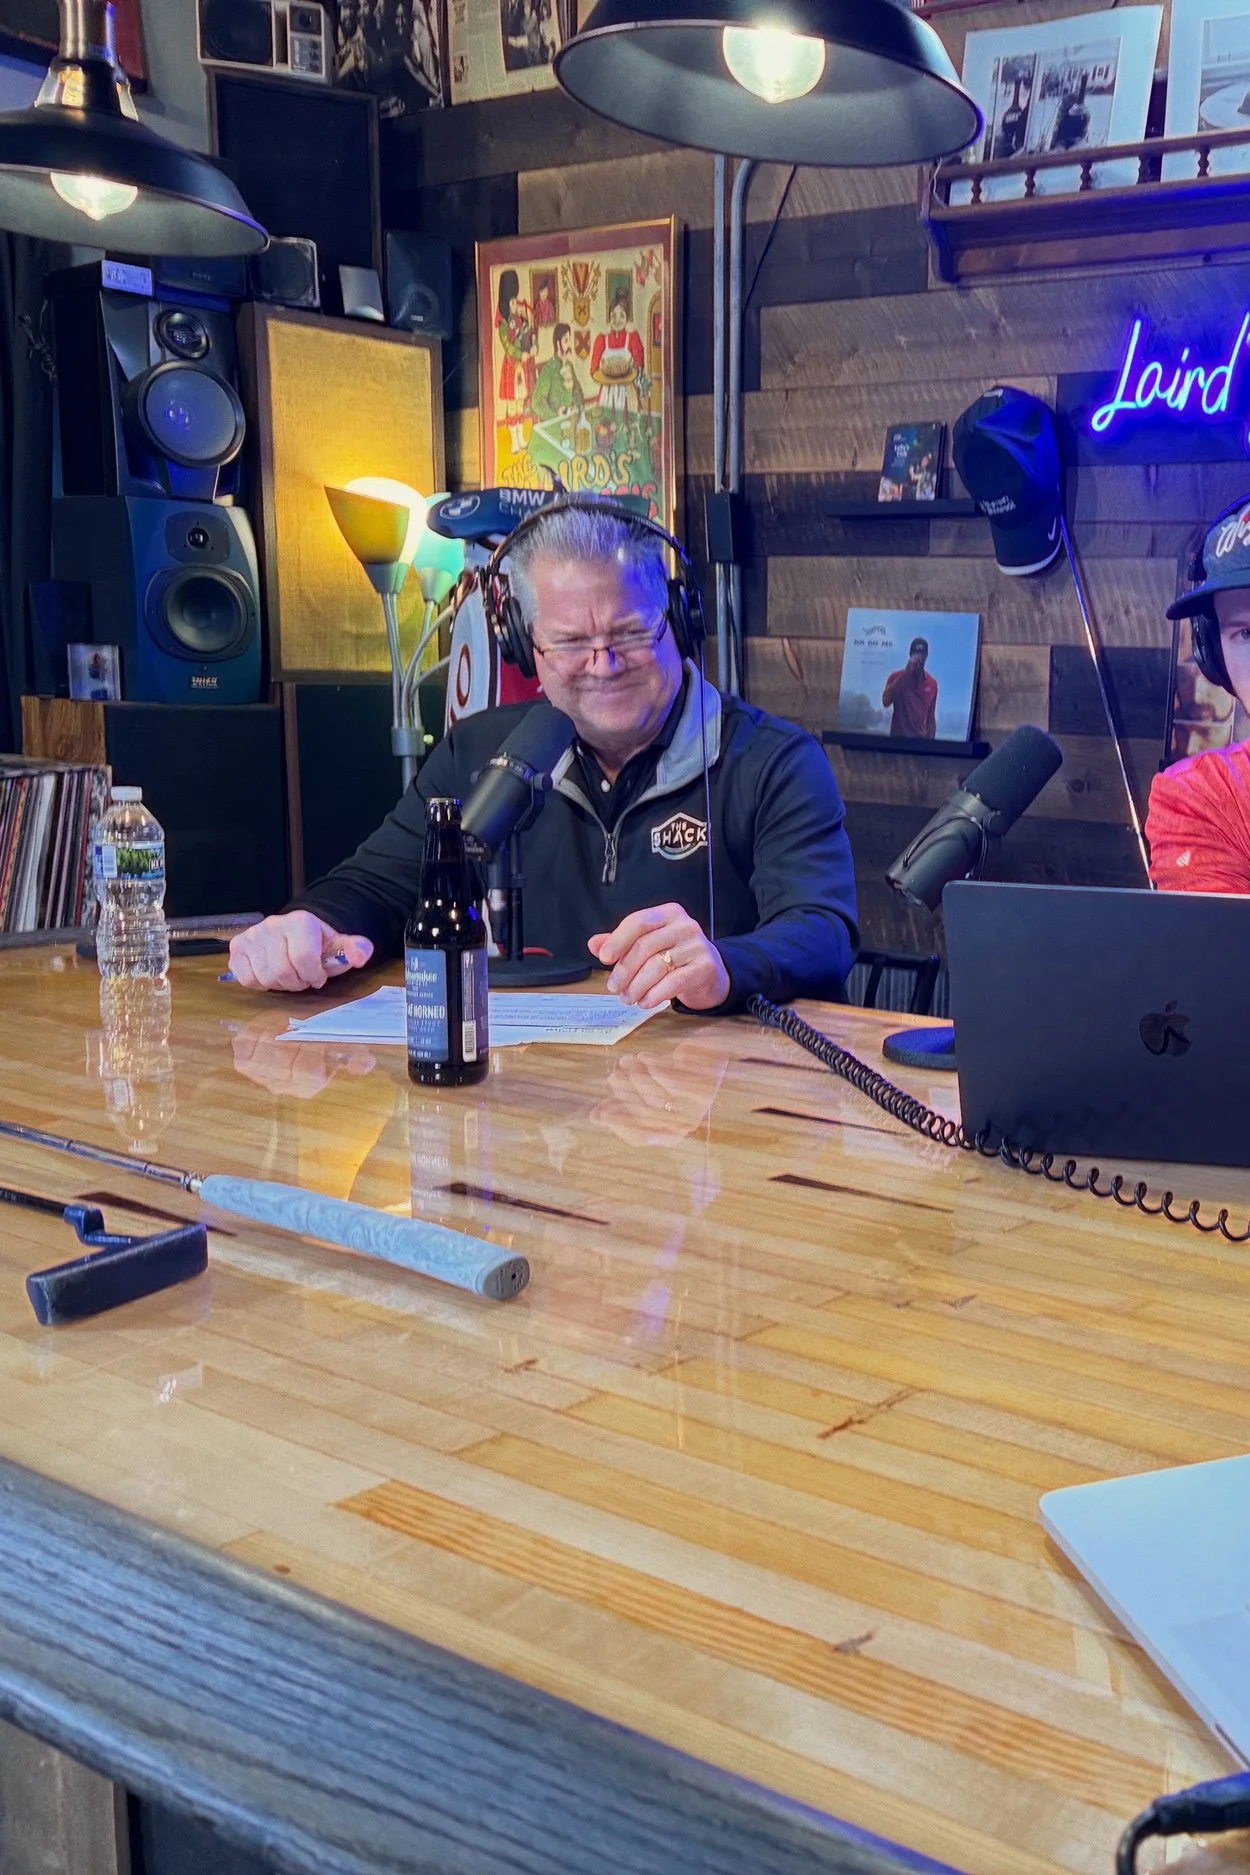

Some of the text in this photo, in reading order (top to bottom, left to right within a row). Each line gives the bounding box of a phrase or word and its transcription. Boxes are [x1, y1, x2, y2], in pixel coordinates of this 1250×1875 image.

[499, 488, 546, 506] BMW
[671, 821, 688, 832] THE
[653, 826, 708, 849] SHACK
